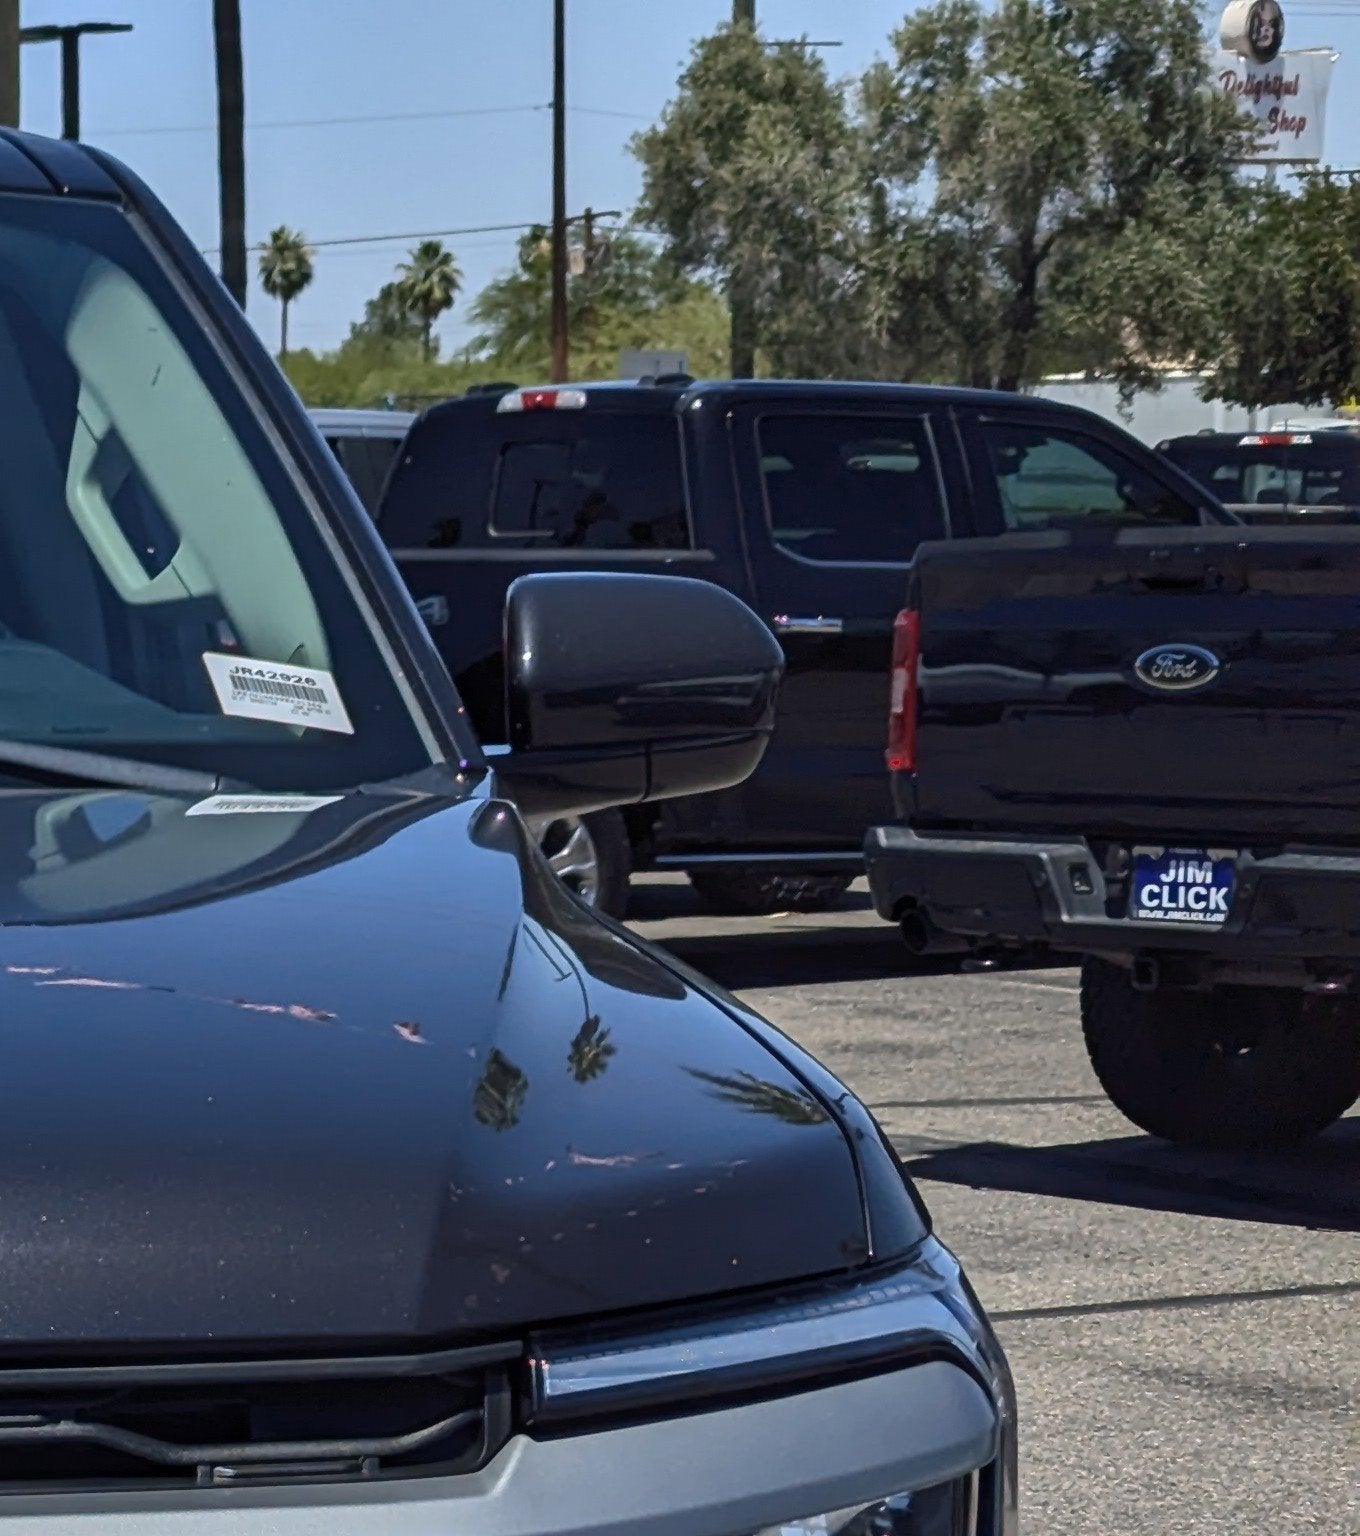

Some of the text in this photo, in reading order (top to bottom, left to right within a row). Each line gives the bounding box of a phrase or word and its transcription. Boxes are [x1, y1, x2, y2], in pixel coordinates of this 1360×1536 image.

[1219, 70, 1300, 104] Delightful
[1268, 106, 1307, 139] Shop
[1151, 653, 1198, 679] Ford
[1159, 860, 1213, 884] JIM
[1140, 884, 1229, 911] CLICK
